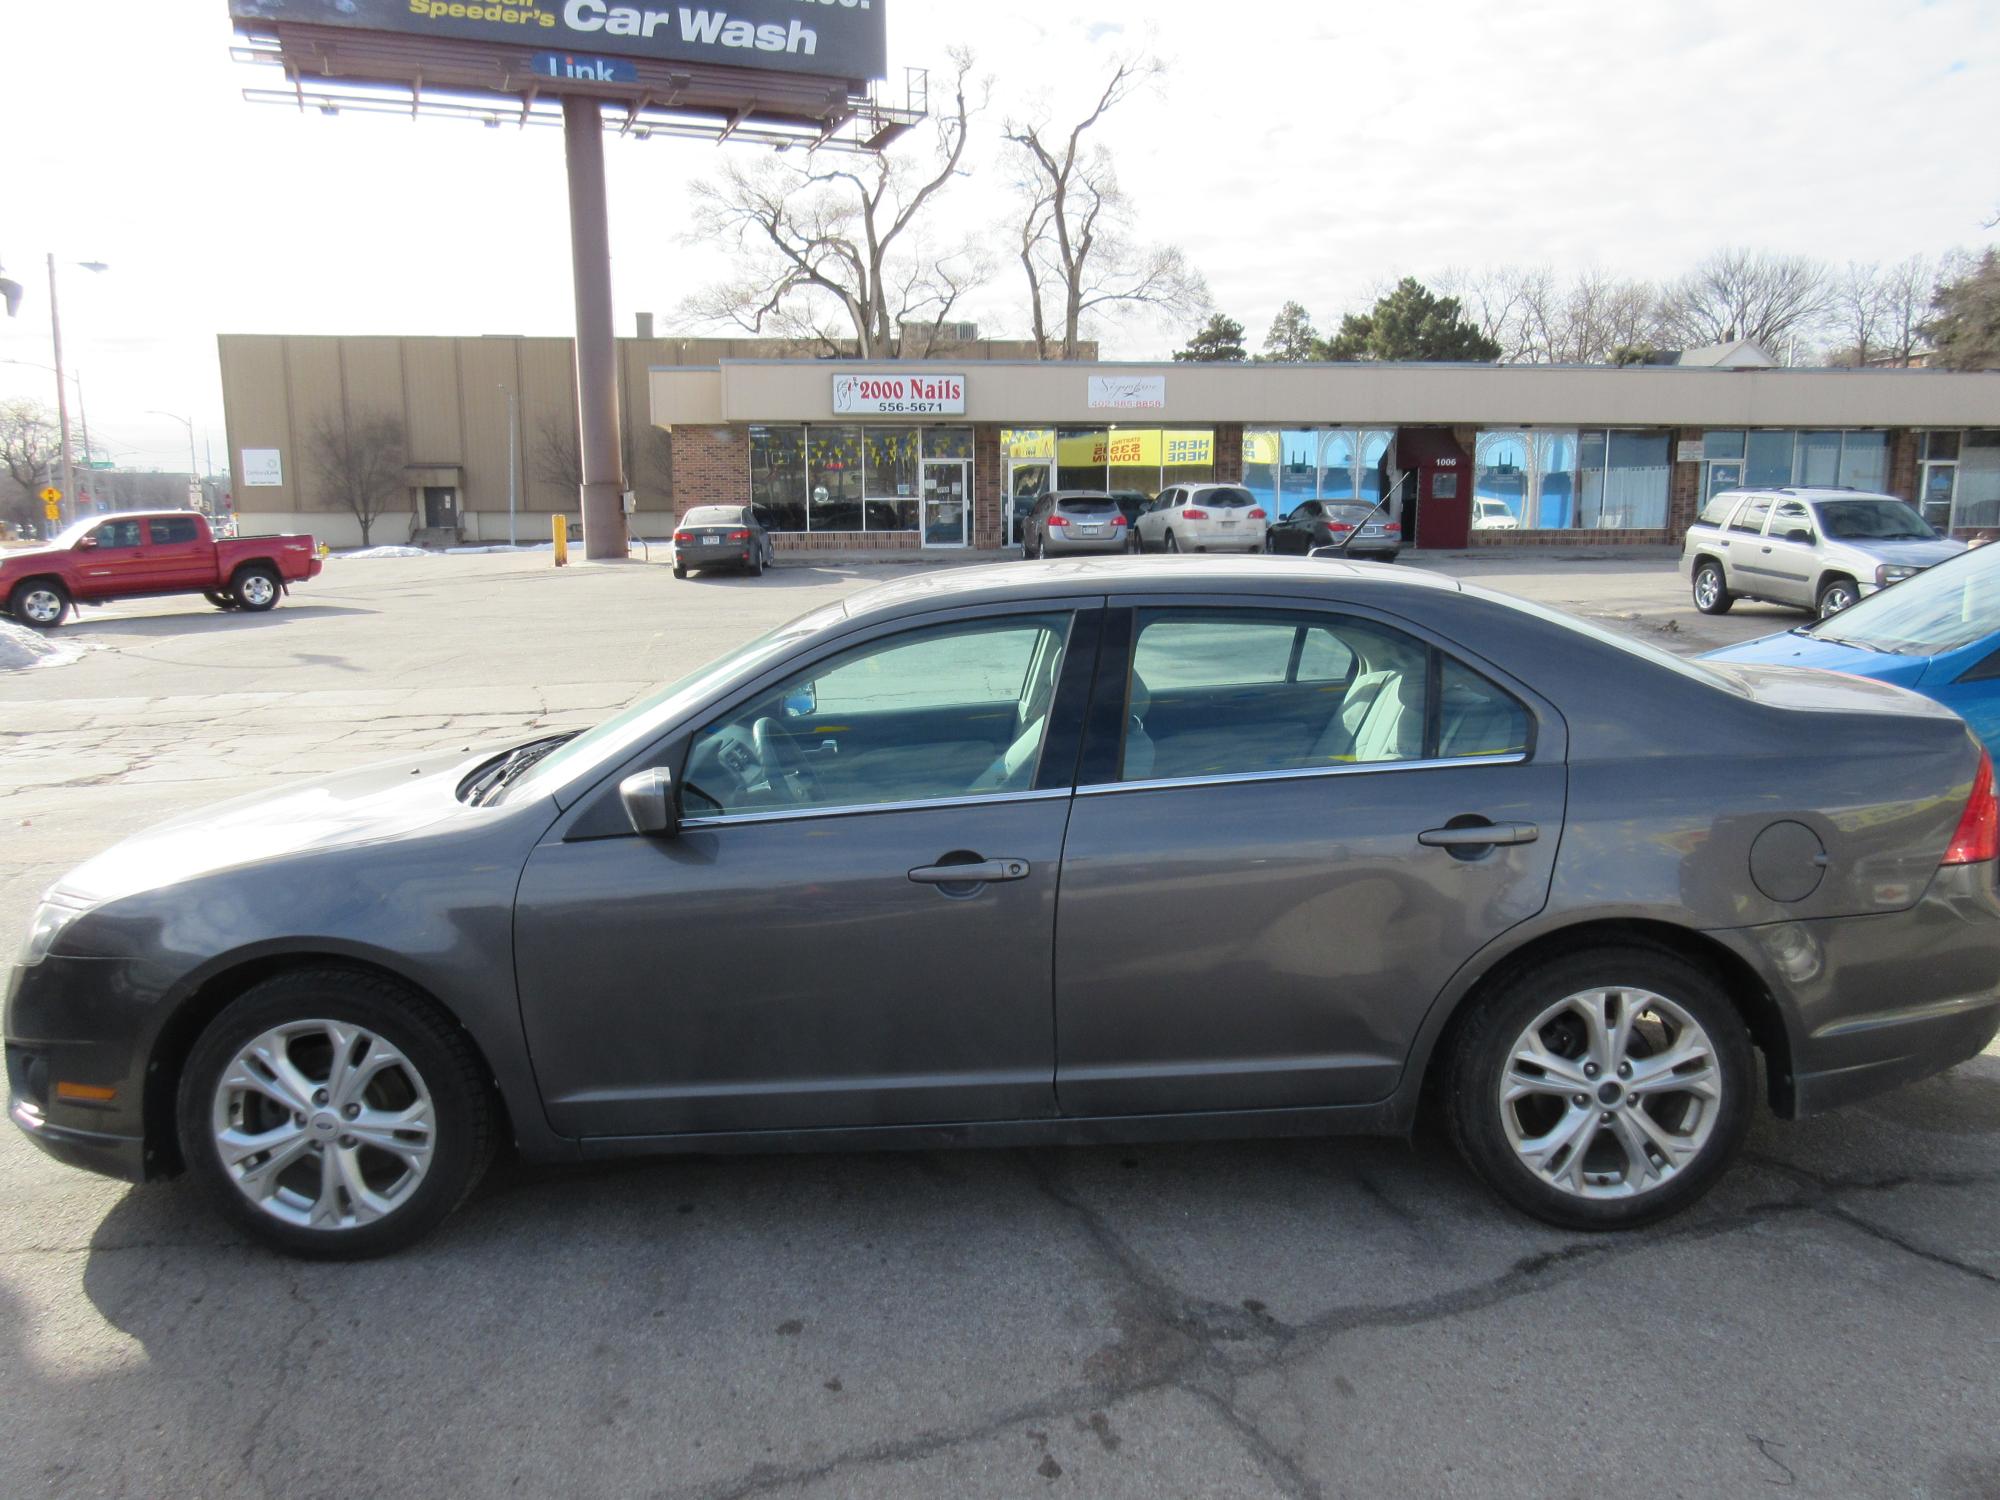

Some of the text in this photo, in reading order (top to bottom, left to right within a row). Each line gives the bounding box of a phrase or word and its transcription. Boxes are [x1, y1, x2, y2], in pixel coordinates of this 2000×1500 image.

[409, 0, 556, 27] Speeder's
[563, 0, 817, 55] Car Wash
[549, 55, 614, 82] Link
[860, 379, 961, 400] 2000 Nails
[879, 402, 943, 412] 556-5671
[1436, 458, 1456, 466] 1006
